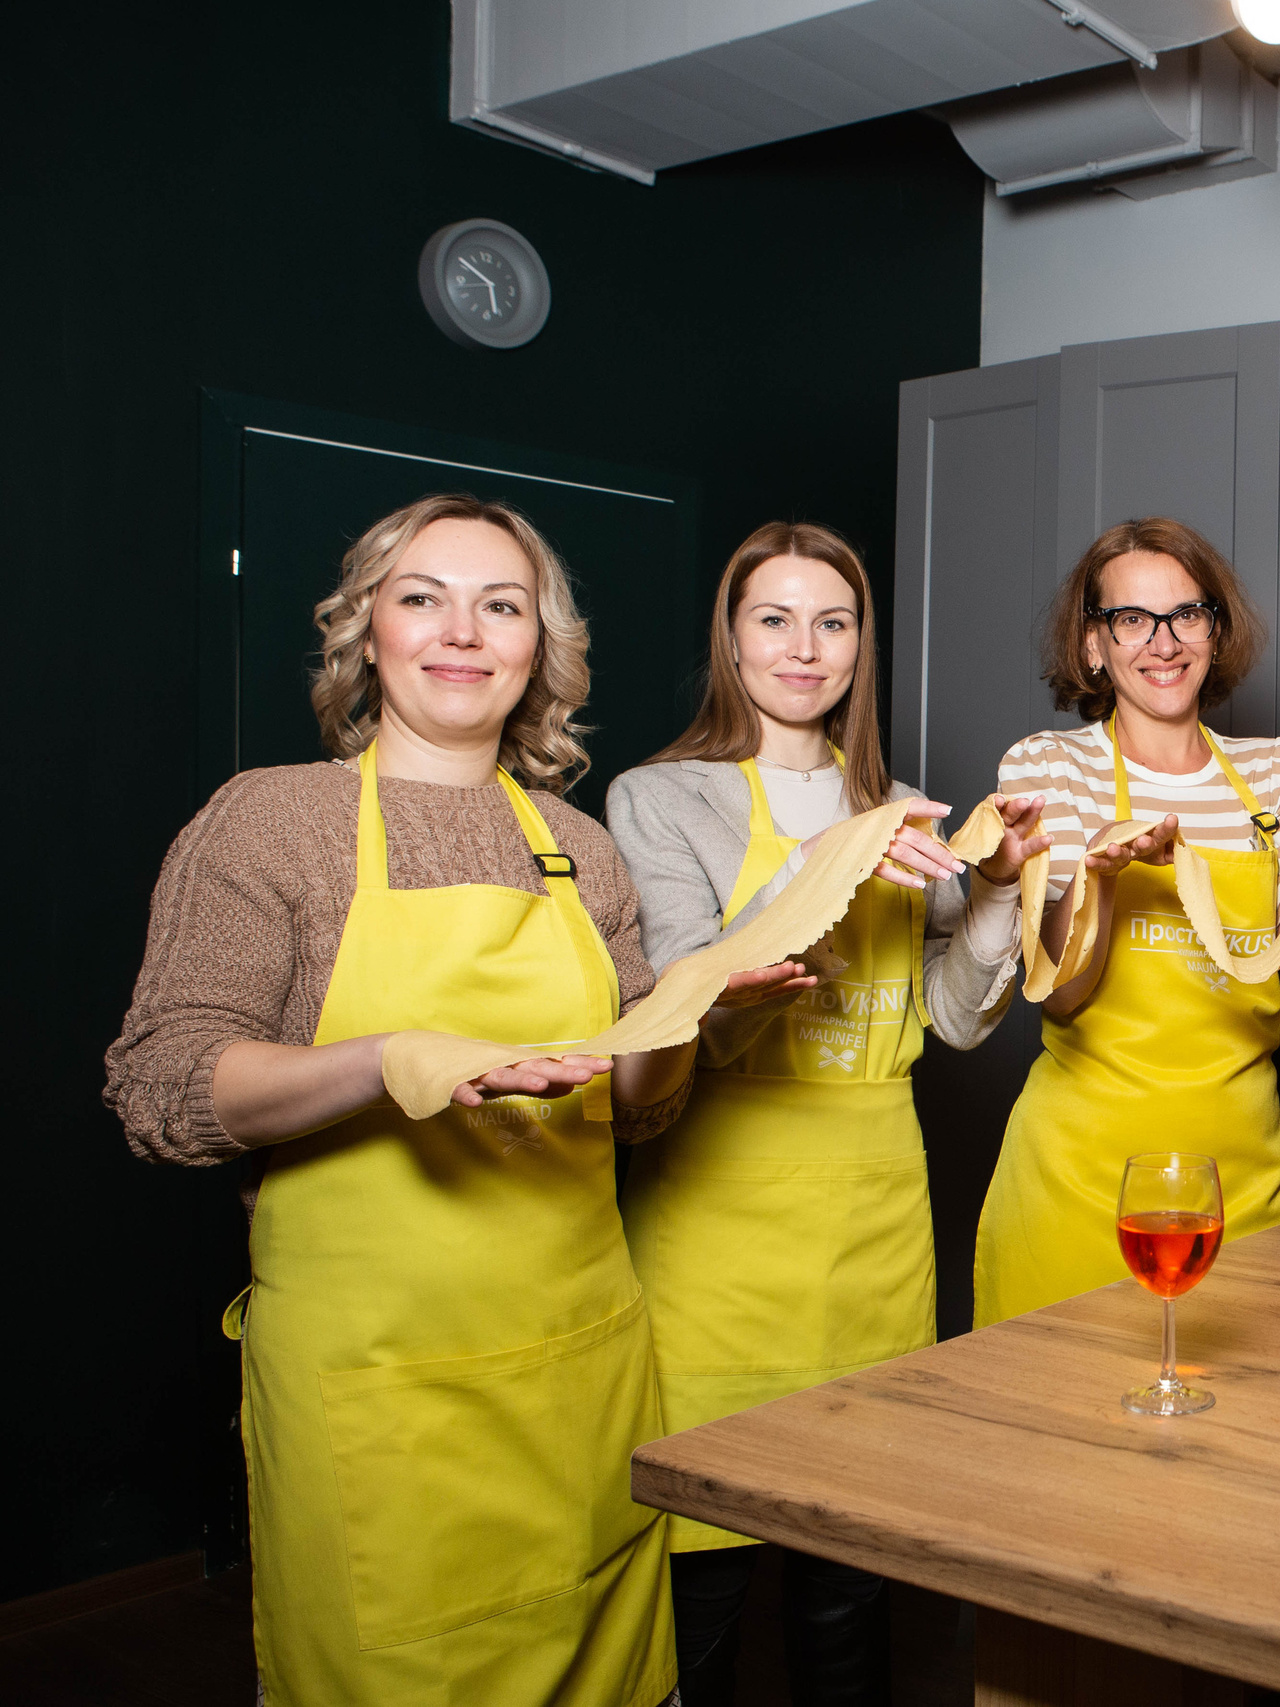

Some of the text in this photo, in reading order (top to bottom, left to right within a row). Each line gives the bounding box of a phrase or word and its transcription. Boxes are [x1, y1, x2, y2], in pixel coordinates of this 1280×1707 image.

[479, 251, 493, 264] 12
[508, 285, 516, 298] 3
[799, 1026, 867, 1049] MAUNFEL
